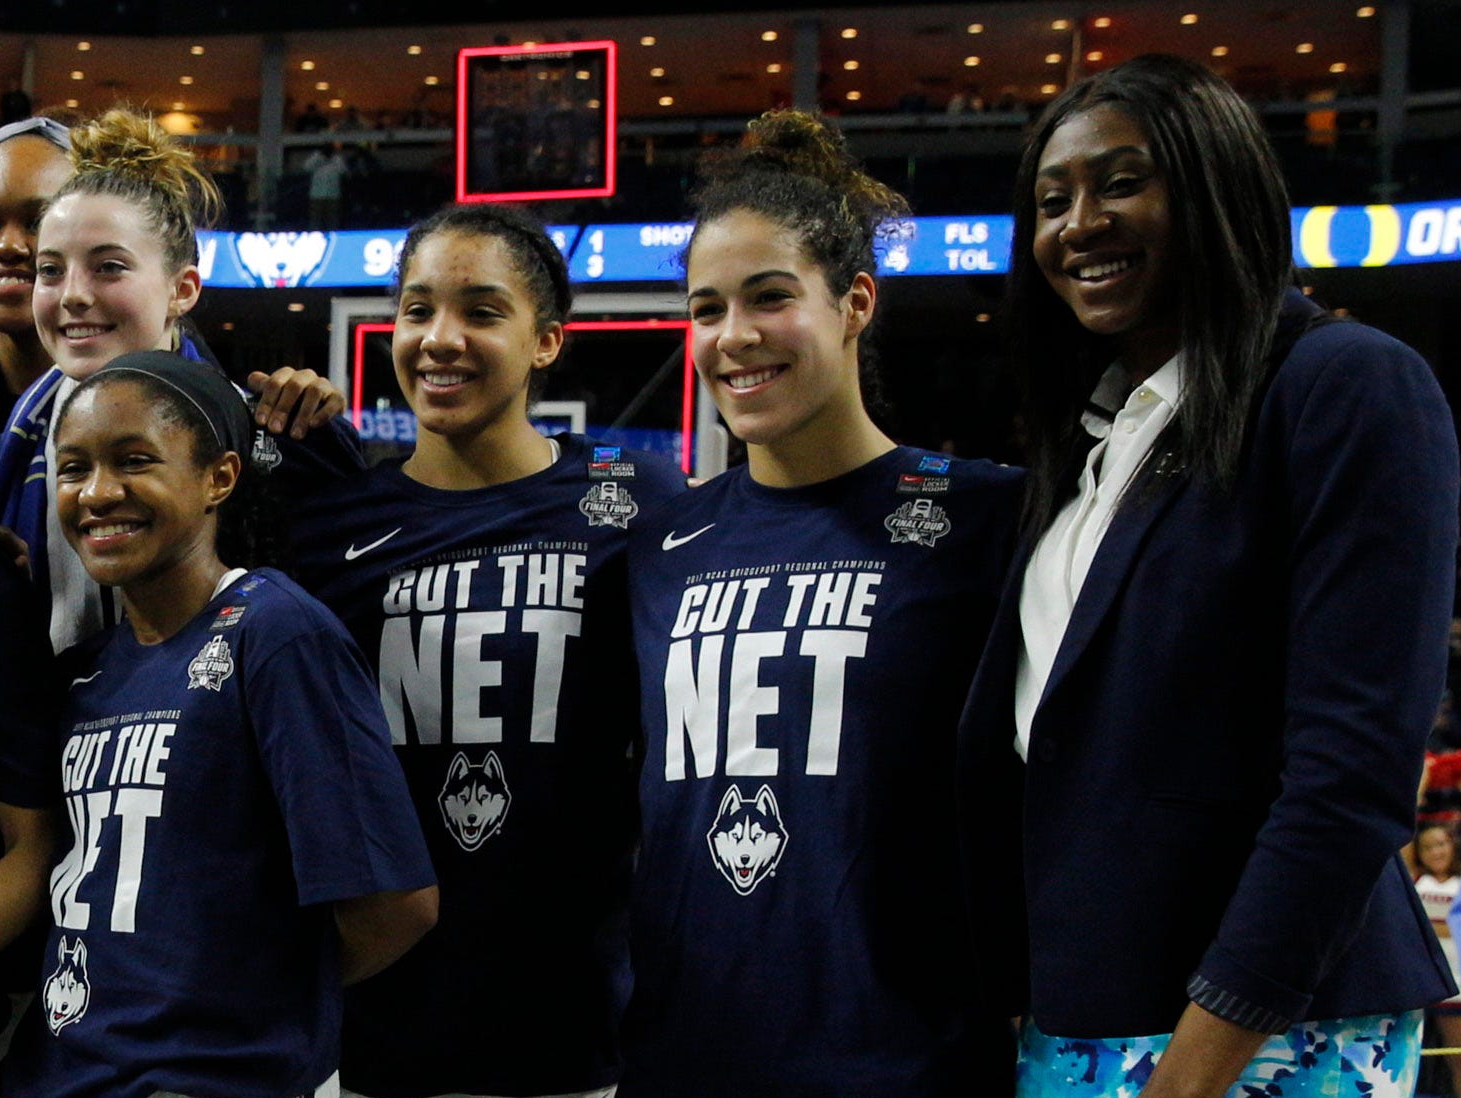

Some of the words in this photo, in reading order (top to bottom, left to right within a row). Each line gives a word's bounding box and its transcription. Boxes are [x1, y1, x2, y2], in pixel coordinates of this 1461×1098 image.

[588, 229, 604, 254] 1
[944, 222, 988, 244] FLS
[944, 249, 997, 271] TOL
[584, 502, 609, 512] FINAL
[609, 504, 633, 514] FOUR
[890, 518, 917, 528] FINAL
[917, 522, 945, 531] FOUR
[493, 542, 533, 555] REGIONAL
[537, 541, 589, 552] CHAMPIONS
[382, 559, 481, 615] CUT
[497, 553, 587, 610] THE
[729, 563, 781, 578] BRIDGEPORT
[784, 560, 828, 572] REGIONAL
[832, 560, 887, 571] CHAMPIONS
[670, 576, 771, 640] CUT
[782, 572, 883, 628] THE
[207, 661, 230, 673] FOUR
[378, 608, 583, 746] NET
[144, 709, 182, 720] CHAMPIONS
[664, 629, 869, 782] NET
[61, 730, 112, 794] CUT
[108, 723, 177, 786] THE
[49, 788, 163, 934] NET
